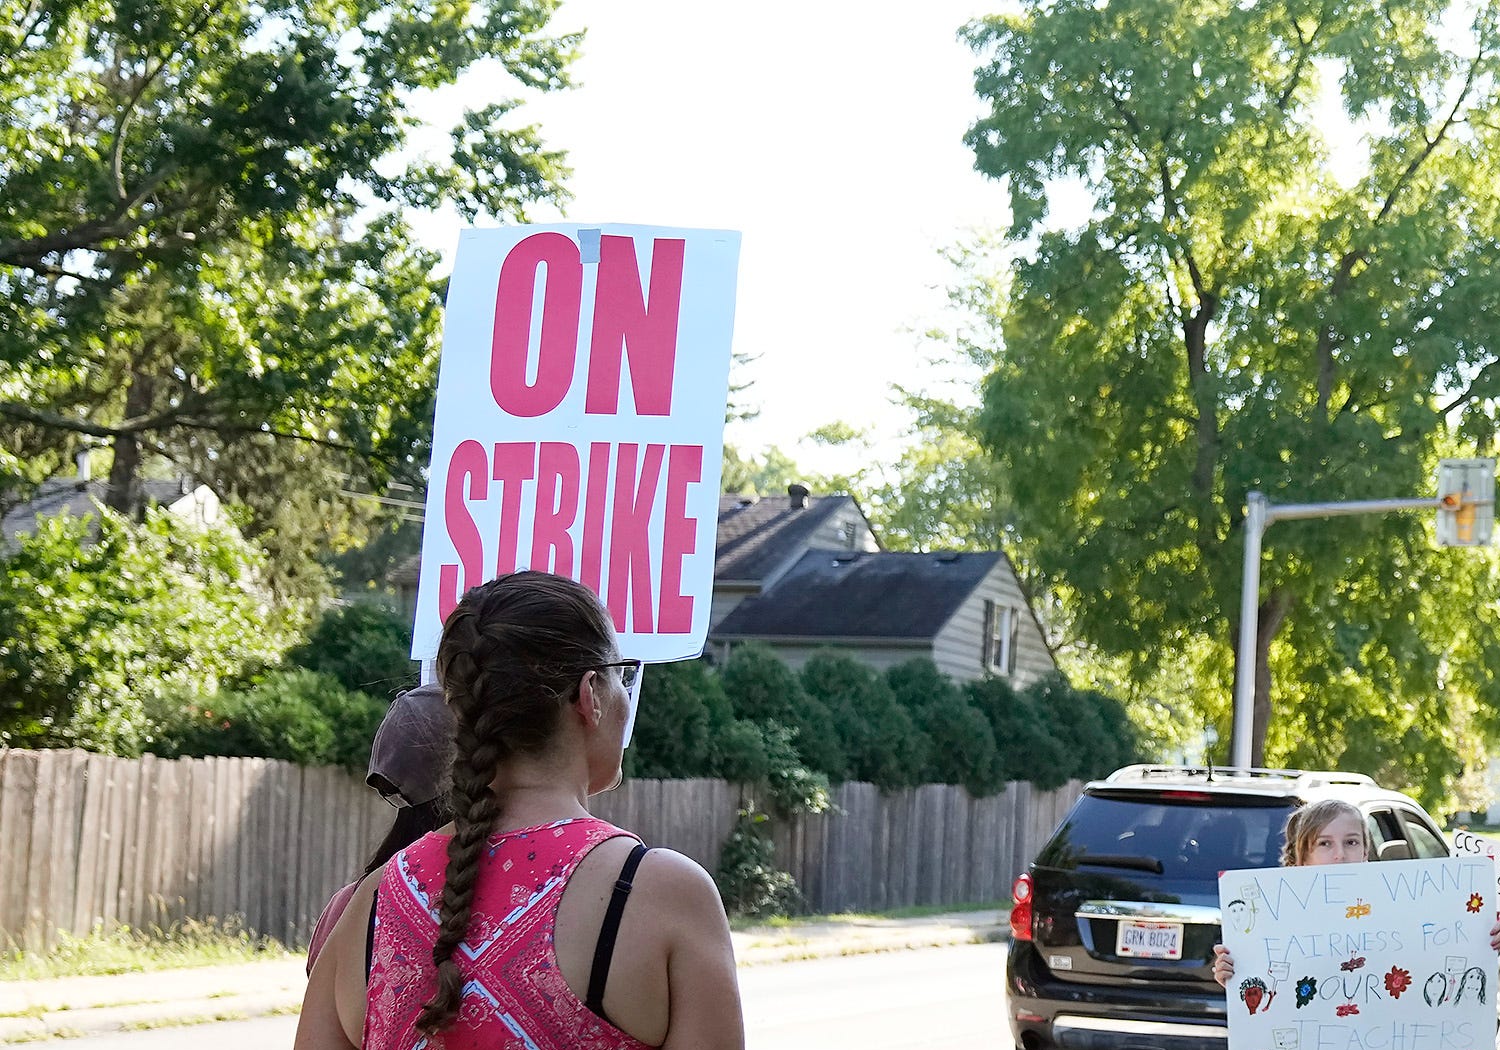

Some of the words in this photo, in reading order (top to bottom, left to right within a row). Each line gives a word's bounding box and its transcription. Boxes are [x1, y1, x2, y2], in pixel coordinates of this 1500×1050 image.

[490, 232, 686, 417] ON
[439, 439, 704, 634] STRIKE
[1455, 832, 1484, 854] CCS
[1254, 872, 1359, 920] WE
[1381, 863, 1486, 901] WANT
[1263, 931, 1403, 965] FAIRNESS
[1422, 920, 1469, 951] FOR
[1318, 973, 1382, 1004] OUR
